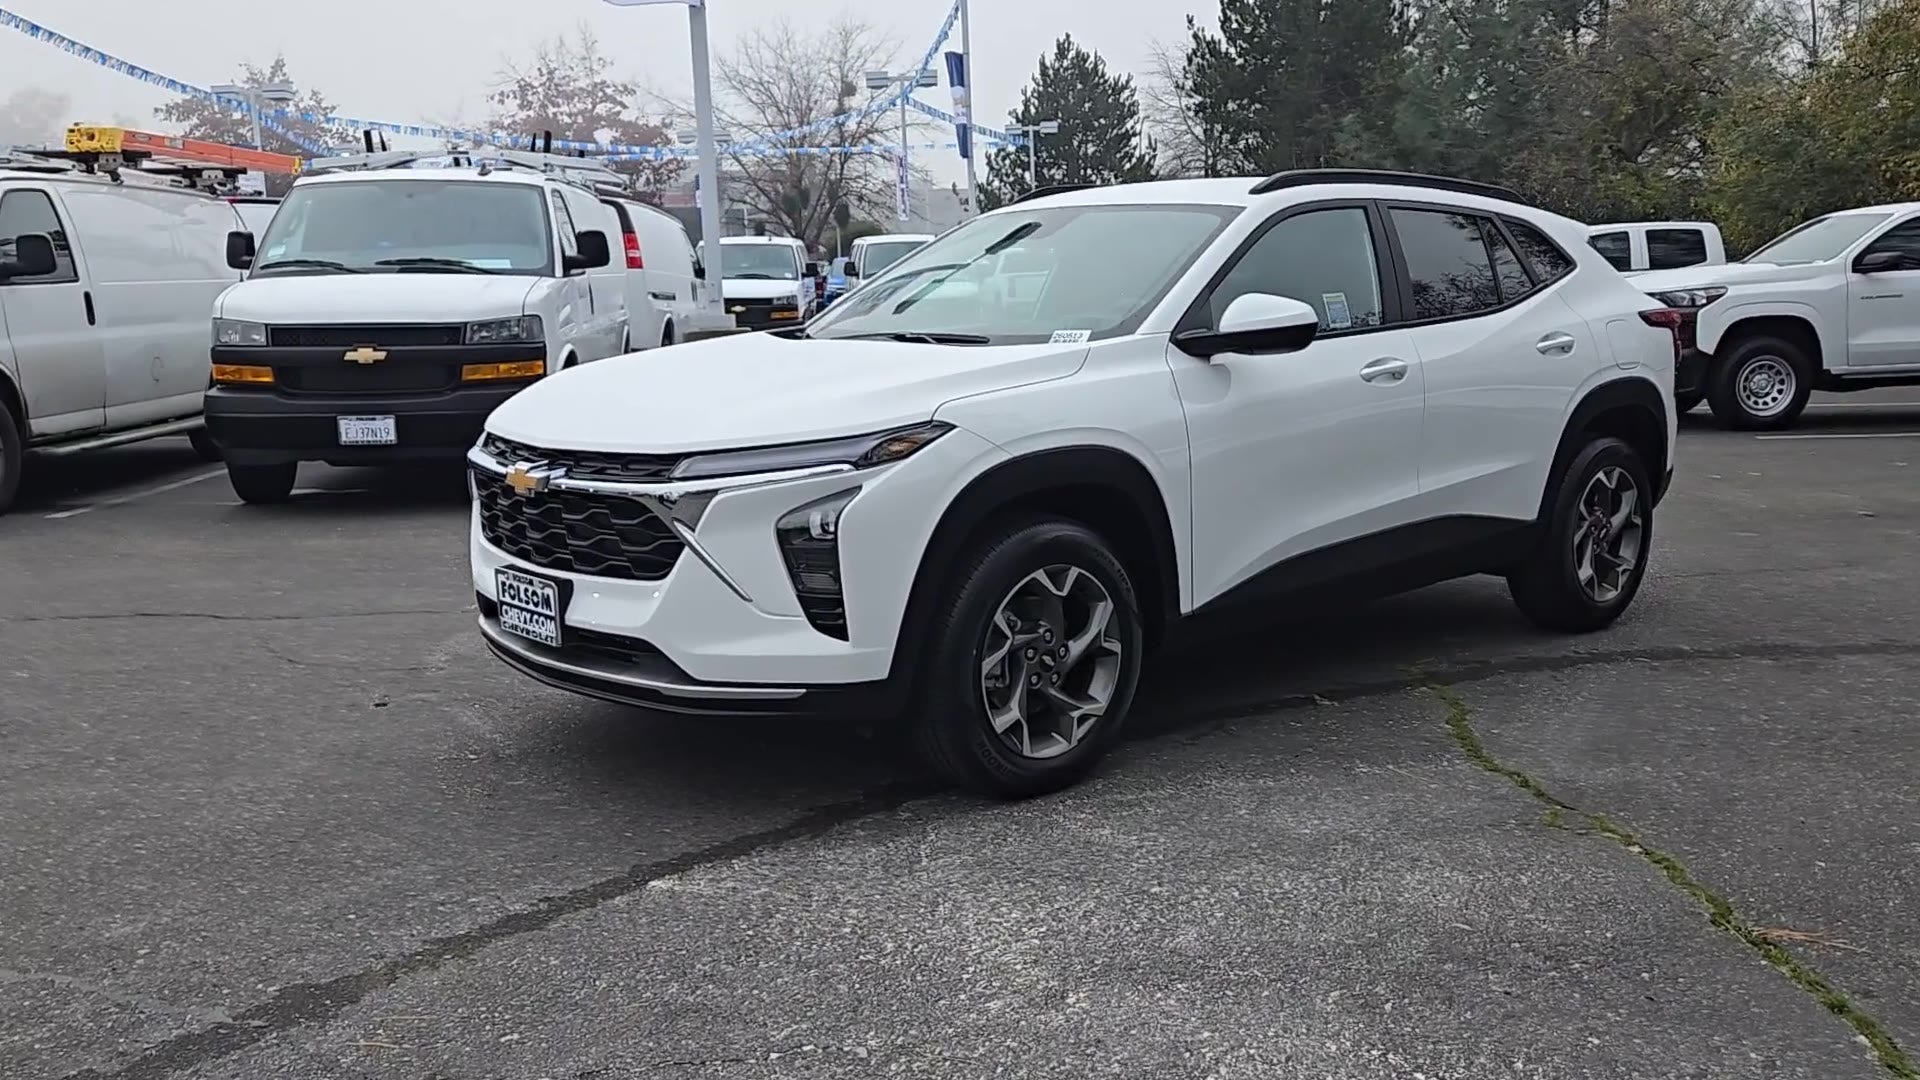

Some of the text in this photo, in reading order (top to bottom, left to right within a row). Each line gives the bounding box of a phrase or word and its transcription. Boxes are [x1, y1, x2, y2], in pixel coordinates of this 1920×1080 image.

[500, 580, 553, 613] FOLSOM
[501, 604, 555, 635] CHEVY.COM
[502, 620, 555, 644] CHEVROLET
